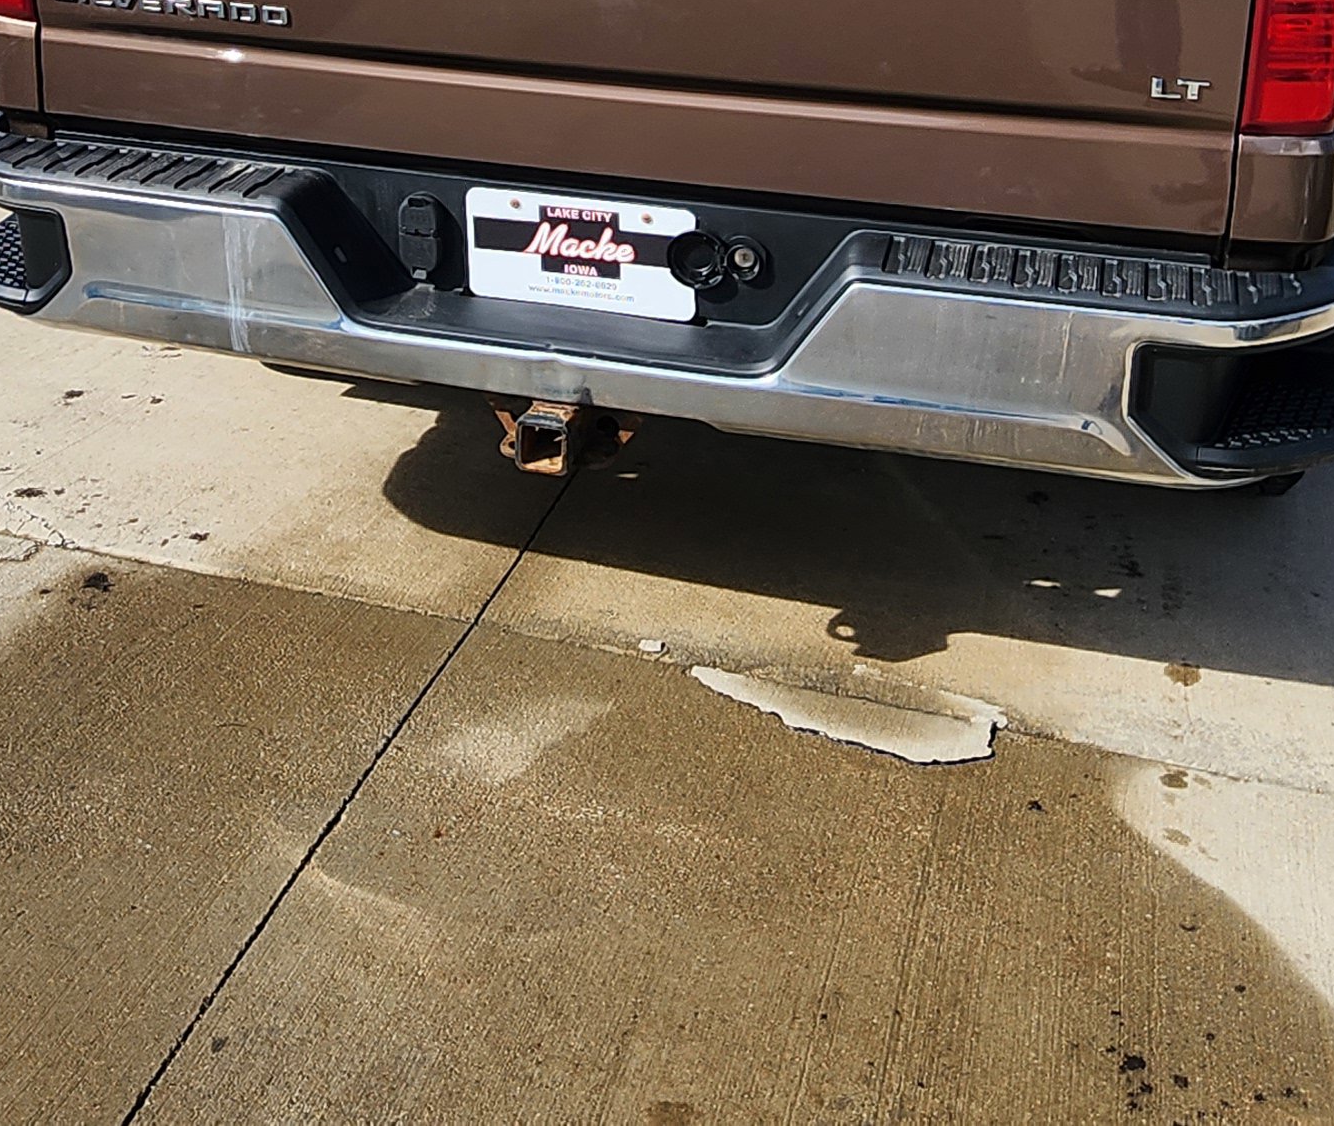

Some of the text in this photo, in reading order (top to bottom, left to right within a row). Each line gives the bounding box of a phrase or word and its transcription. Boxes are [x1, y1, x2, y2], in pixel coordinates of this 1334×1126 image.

[1150, 76, 1210, 100] LT
[547, 207, 612, 222] LAKE CITY
[523, 221, 635, 263] Macke
[564, 264, 598, 276] IOWA
